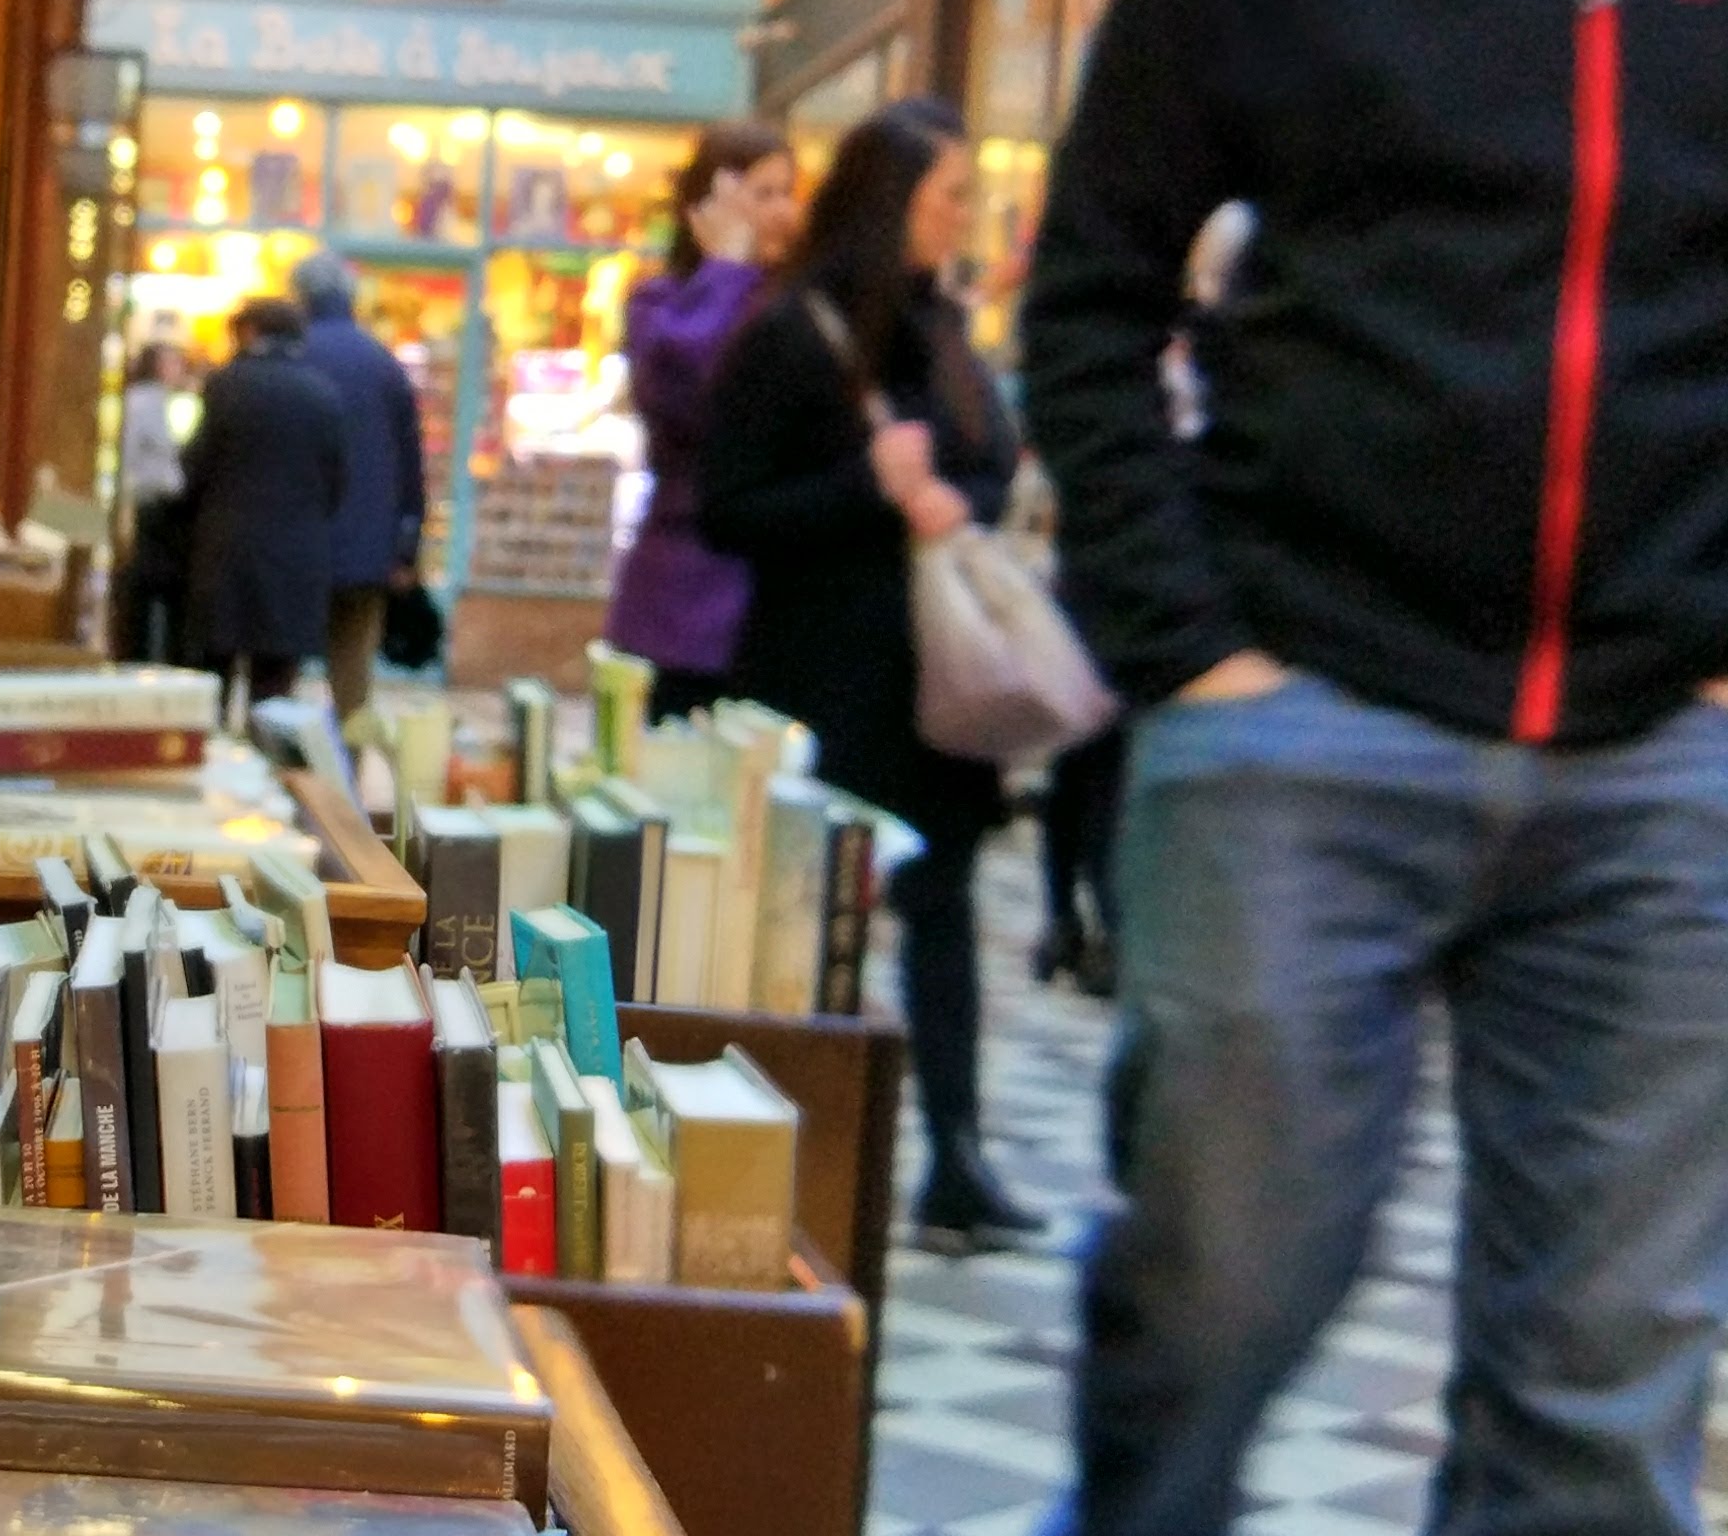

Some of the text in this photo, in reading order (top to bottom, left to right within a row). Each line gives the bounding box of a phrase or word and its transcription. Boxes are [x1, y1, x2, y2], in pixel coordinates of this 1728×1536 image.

[96, 1103, 120, 1213] DE LA MANCHE
[186, 1098, 199, 1135] BERN
[198, 1086, 216, 1211] FRANCK FERRAND
[500, 1429, 517, 1501] ALLIMARD
